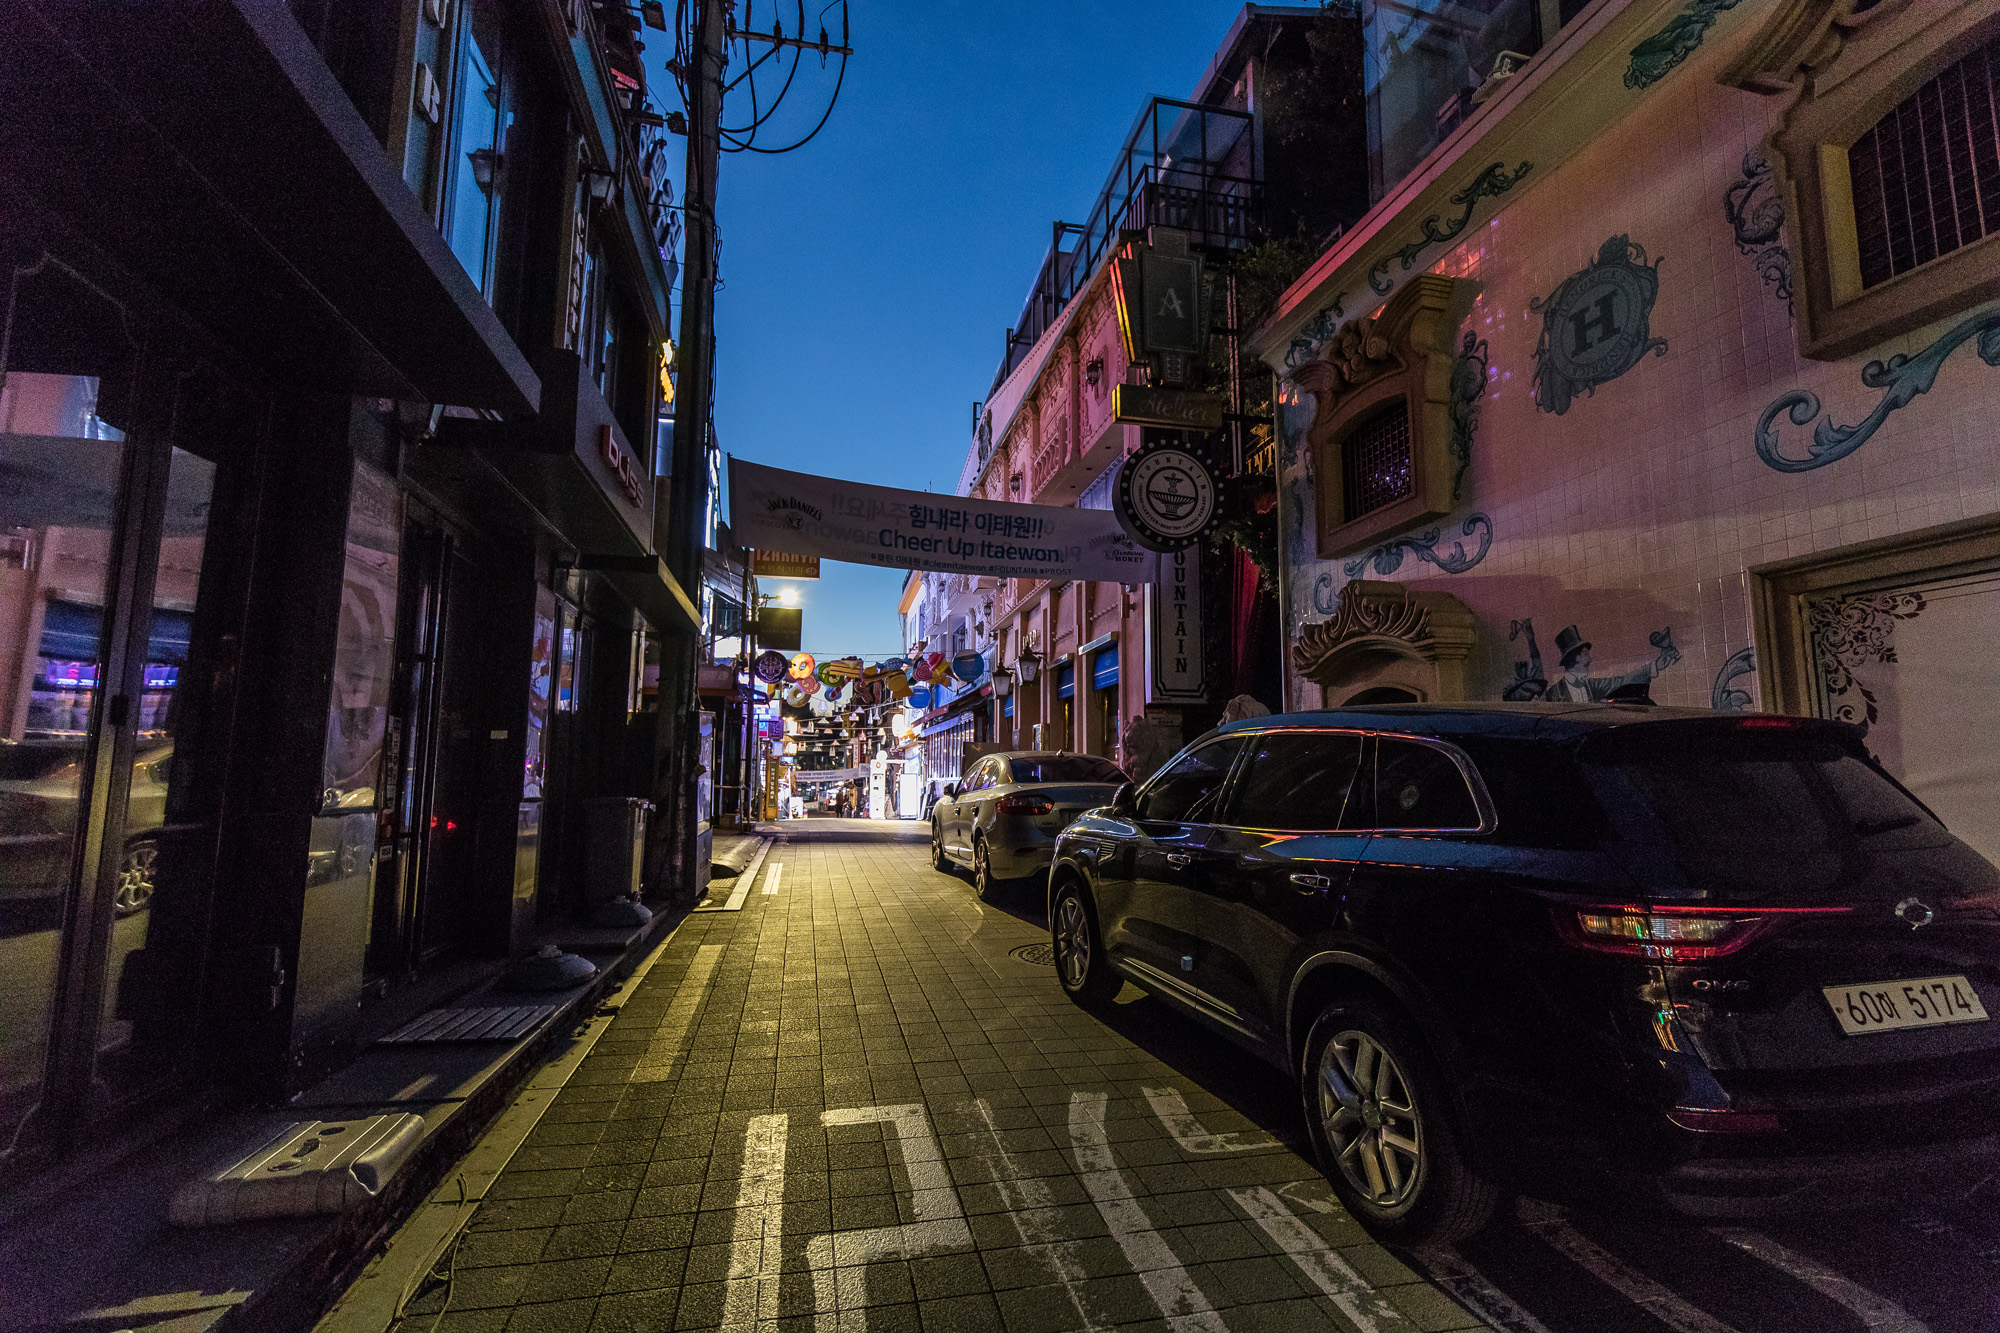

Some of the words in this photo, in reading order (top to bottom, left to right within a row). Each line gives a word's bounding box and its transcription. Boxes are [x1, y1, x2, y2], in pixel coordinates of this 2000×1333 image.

[1156, 287, 1186, 319] A
[1568, 288, 1622, 359] H
[1139, 392, 1209, 421] Atelier
[1138, 456, 1207, 490] FOUNTAIN
[767, 498, 789, 512] JACK
[789, 496, 824, 522] DANIEL'S
[908, 504, 968, 532] 힘내라
[974, 513, 1043, 539] 이태원!!
[878, 528, 943, 553] Cheer
[946, 535, 975, 561] Up
[980, 538, 1064, 564] Itaewon.
[1114, 556, 1145, 564] HONEY
[895, 555, 921, 566] 이태원
[923, 559, 987, 572] #cleanitaewon
[988, 564, 1038, 575] #FOUNTAIN
[1039, 567, 1073, 576] #PROST
[1173, 551, 1188, 674] OUNTAIN
[1902, 982, 1974, 1020] 5174
